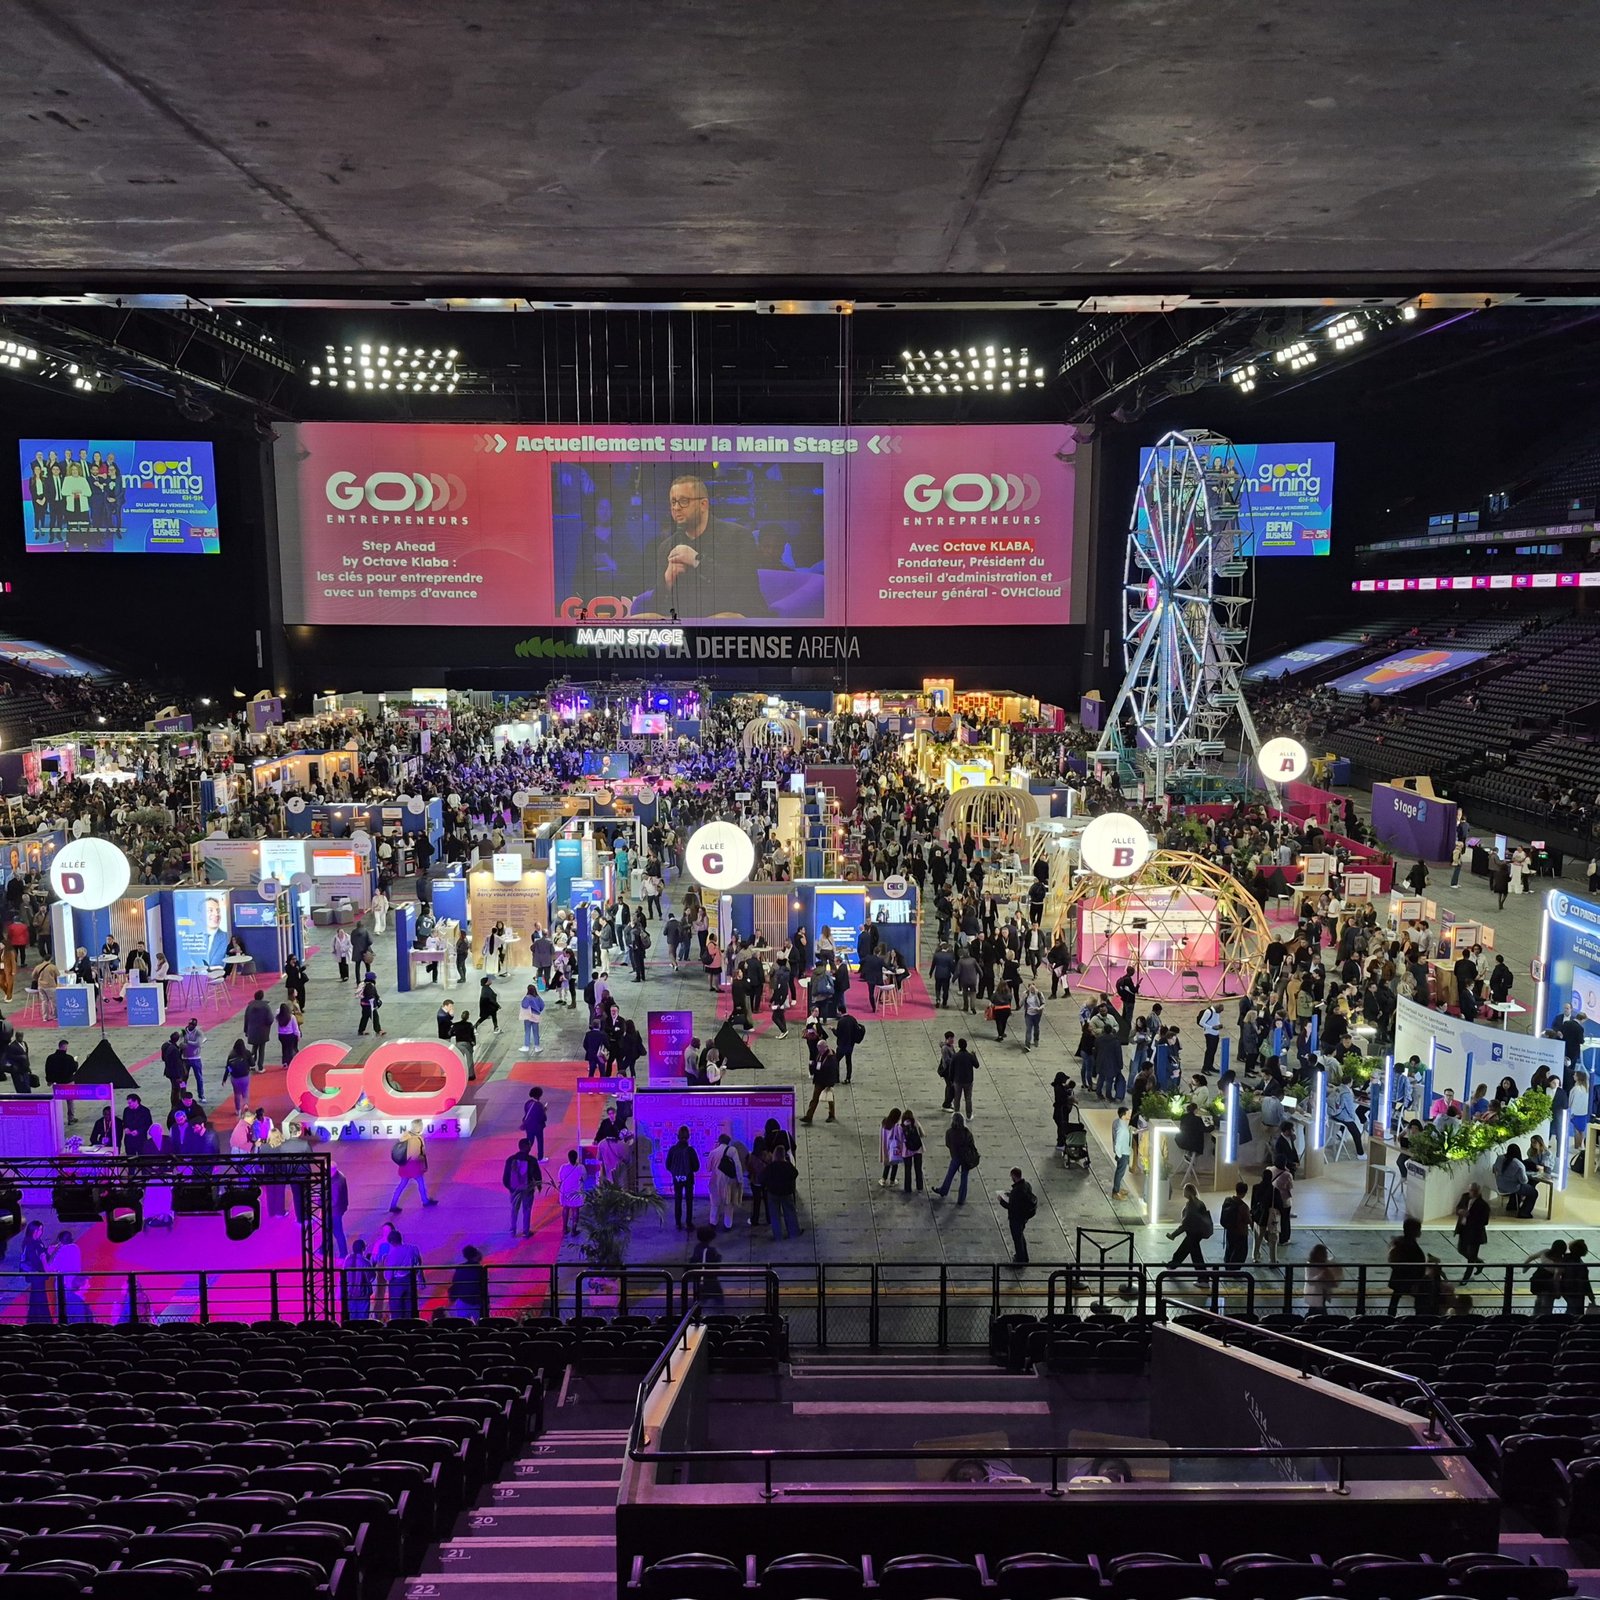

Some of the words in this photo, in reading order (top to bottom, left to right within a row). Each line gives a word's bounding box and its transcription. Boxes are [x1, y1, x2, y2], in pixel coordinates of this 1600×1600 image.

[515, 435, 665, 453] Actuellement
[670, 438, 706, 453] sur
[712, 435, 731, 452] la
[736, 435, 788, 453] Main
[793, 435, 858, 455] Stage
[152, 518, 180, 529] BFM
[327, 514, 470, 525] ENTREPRENEURS
[903, 516, 1041, 526] ENTREPRENEURS
[1266, 521, 1293, 531] BFM
[362, 541, 391, 553] Step
[395, 541, 436, 552] Ahead
[909, 542, 939, 552] Avec
[943, 541, 986, 552] Octave
[990, 541, 1034, 553] KLABA,
[343, 556, 358, 568] by
[363, 556, 407, 567] Octave
[411, 556, 449, 567] Klaba
[897, 557, 965, 569] Fondateur,
[969, 556, 1025, 567] Président
[1029, 556, 1045, 567] du
[317, 571, 334, 581] les
[338, 571, 363, 582] clés
[366, 573, 396, 584] pour
[400, 573, 484, 585] entreprendre
[888, 572, 932, 583] conseil
[936, 571, 1037, 583] d'administration
[1040, 572, 1052, 582] et
[324, 589, 354, 597] avec
[358, 589, 374, 597] un
[377, 588, 416, 600] temps
[420, 588, 478, 598] d'avance
[879, 588, 937, 599] Directeur
[941, 587, 988, 600] général
[1000, 586, 1061, 598] OVHCloud
[577, 628, 625, 645] MAIN
[627, 628, 684, 645] STAGE
[595, 640, 660, 659] PARIS
[666, 637, 691, 659] LA
[696, 636, 792, 659] DEFENSE
[798, 636, 860, 659] ARENA
[1280, 758, 1295, 771] A
[1394, 798, 1417, 818] Stage
[1417, 800, 1427, 822] 2
[700, 842, 725, 850] ALLÉE
[1112, 847, 1134, 867] B
[61, 860, 86, 868] ALLÉE
[702, 852, 724, 875] C
[61, 873, 85, 894] D
[286, 1038, 469, 1118] GO
[682, 1097, 743, 1106] BIENVENUE
[303, 1124, 462, 1137] NTREPRENURS
[500, 1489, 514, 1497] 19
[474, 1516, 494, 1524] 20
[447, 1549, 465, 1558] 21
[412, 1584, 436, 1594] 22
